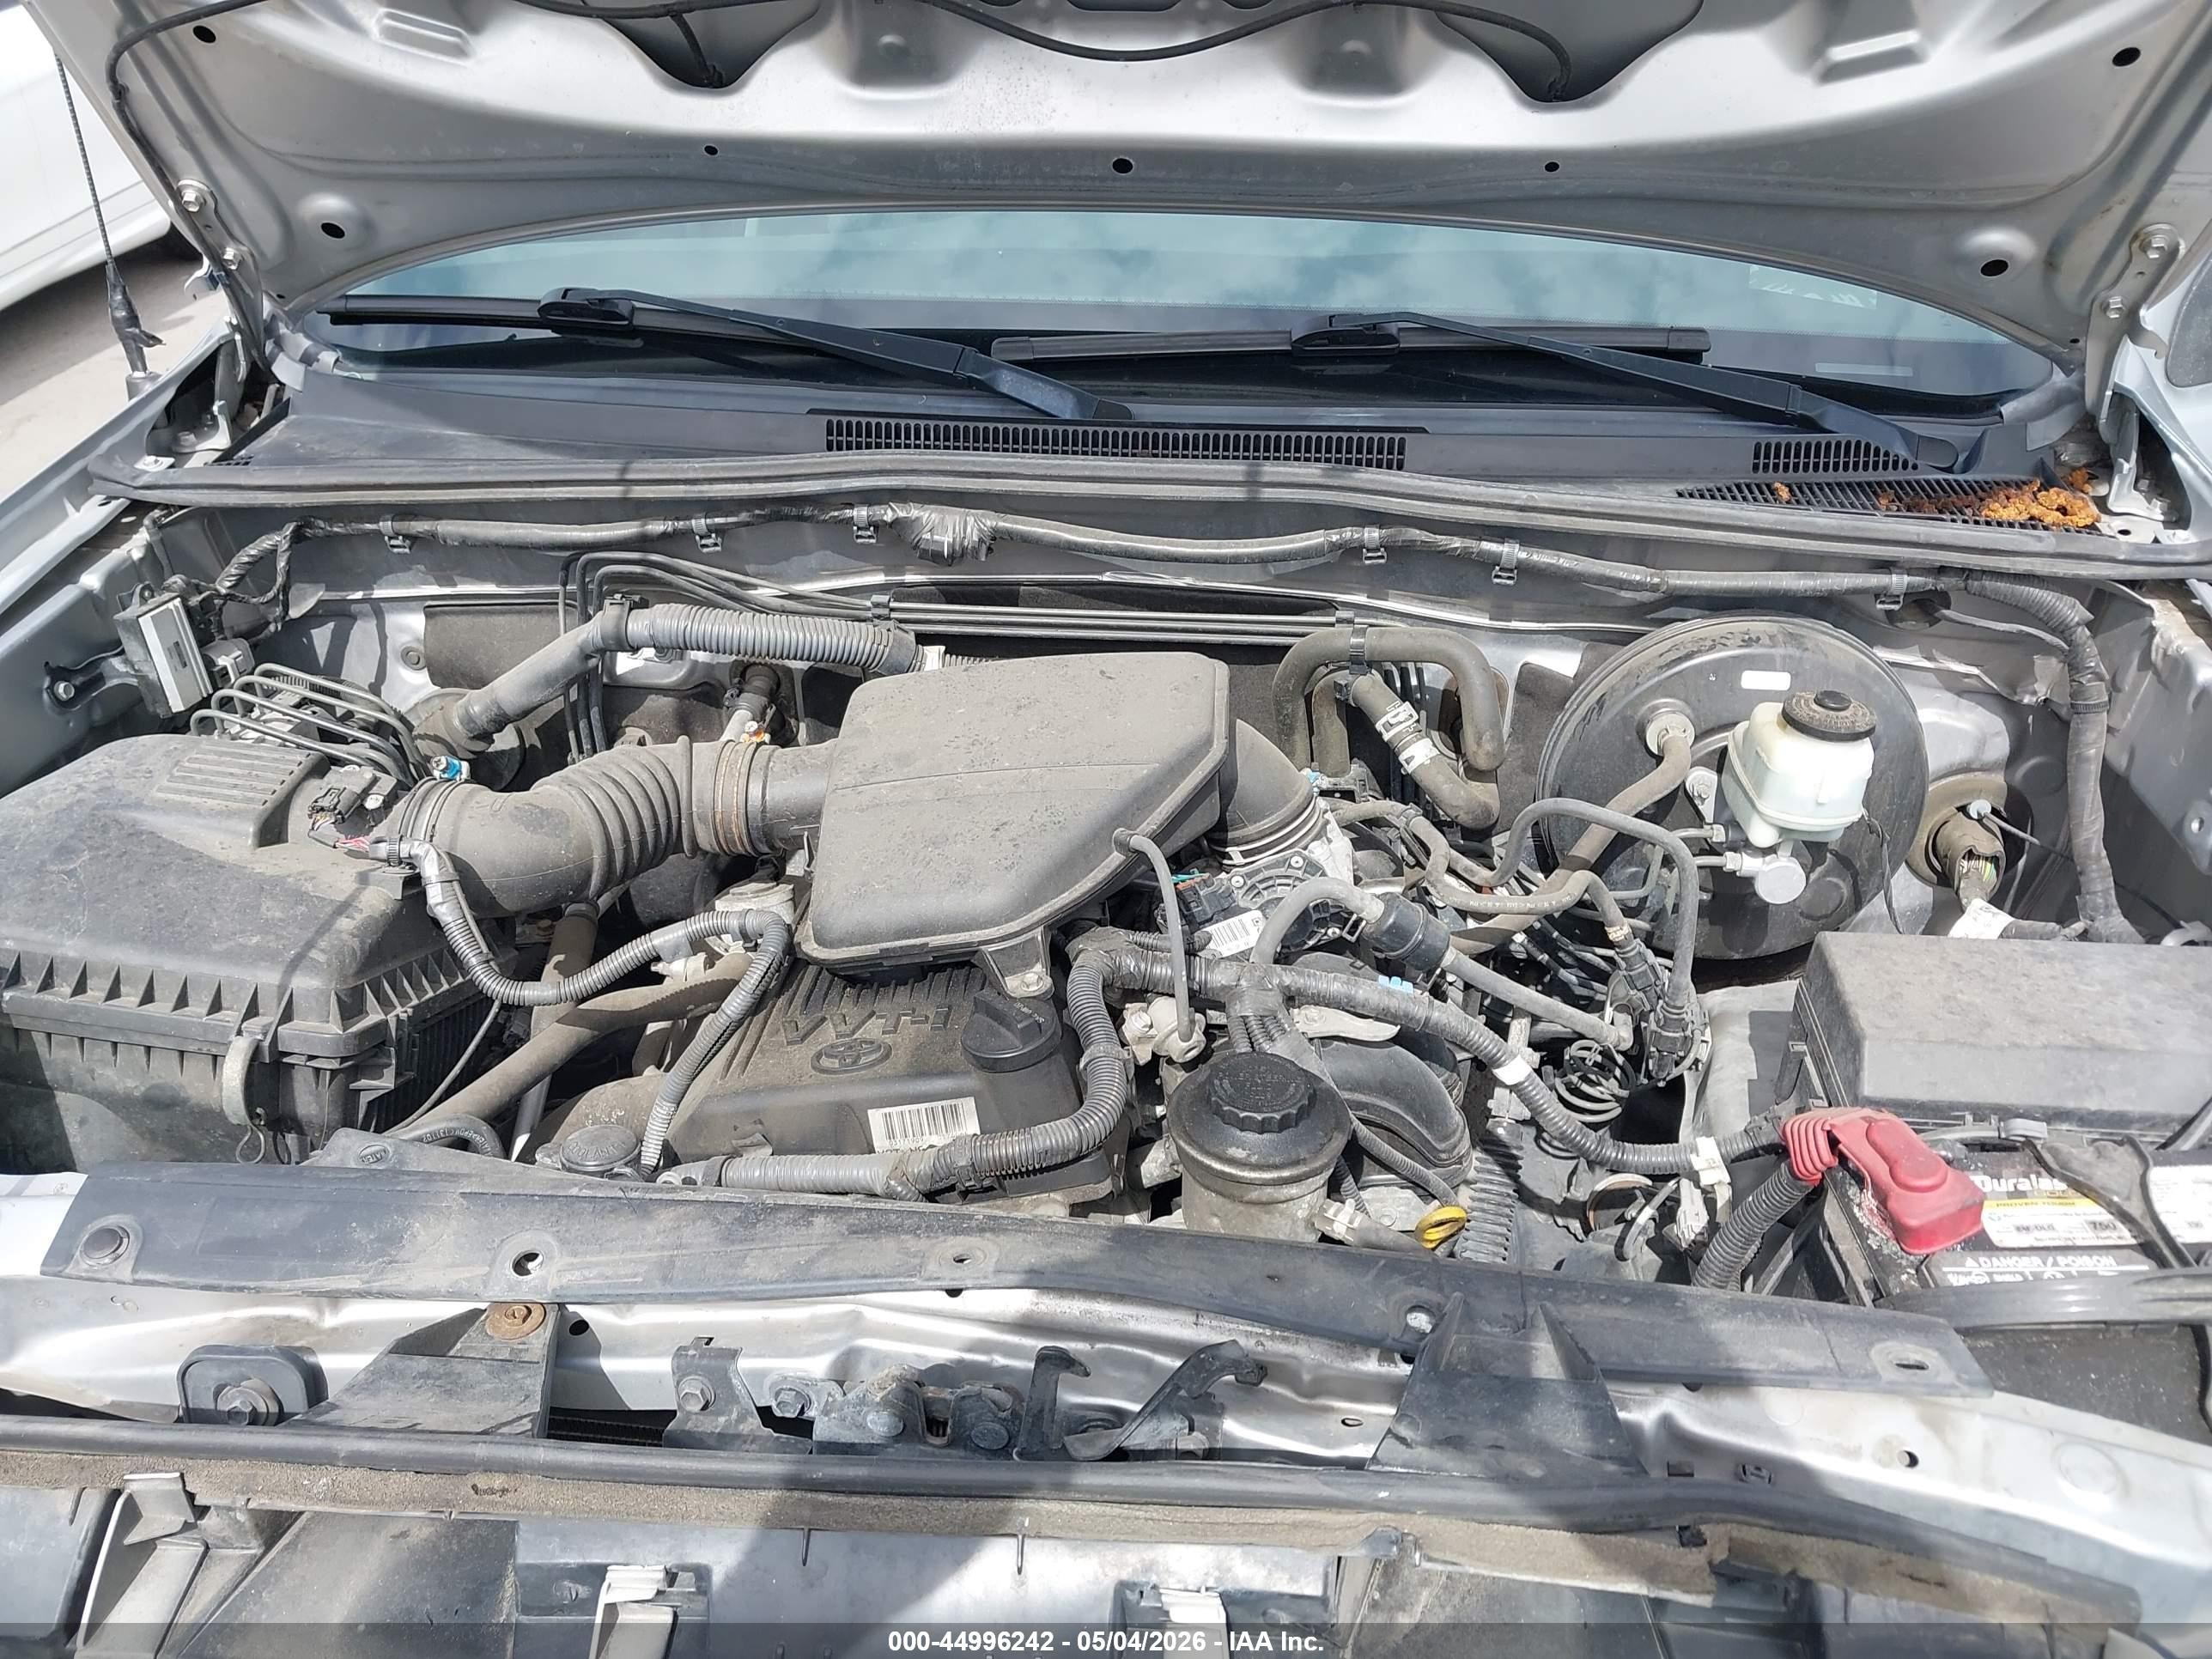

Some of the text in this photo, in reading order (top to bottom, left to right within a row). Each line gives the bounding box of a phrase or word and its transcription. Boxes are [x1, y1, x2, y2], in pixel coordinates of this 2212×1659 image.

[1970, 1175, 2068, 1192] Duralas
[1978, 1255, 2044, 1268] DANGER
[2061, 1255, 2118, 1267] POISON
